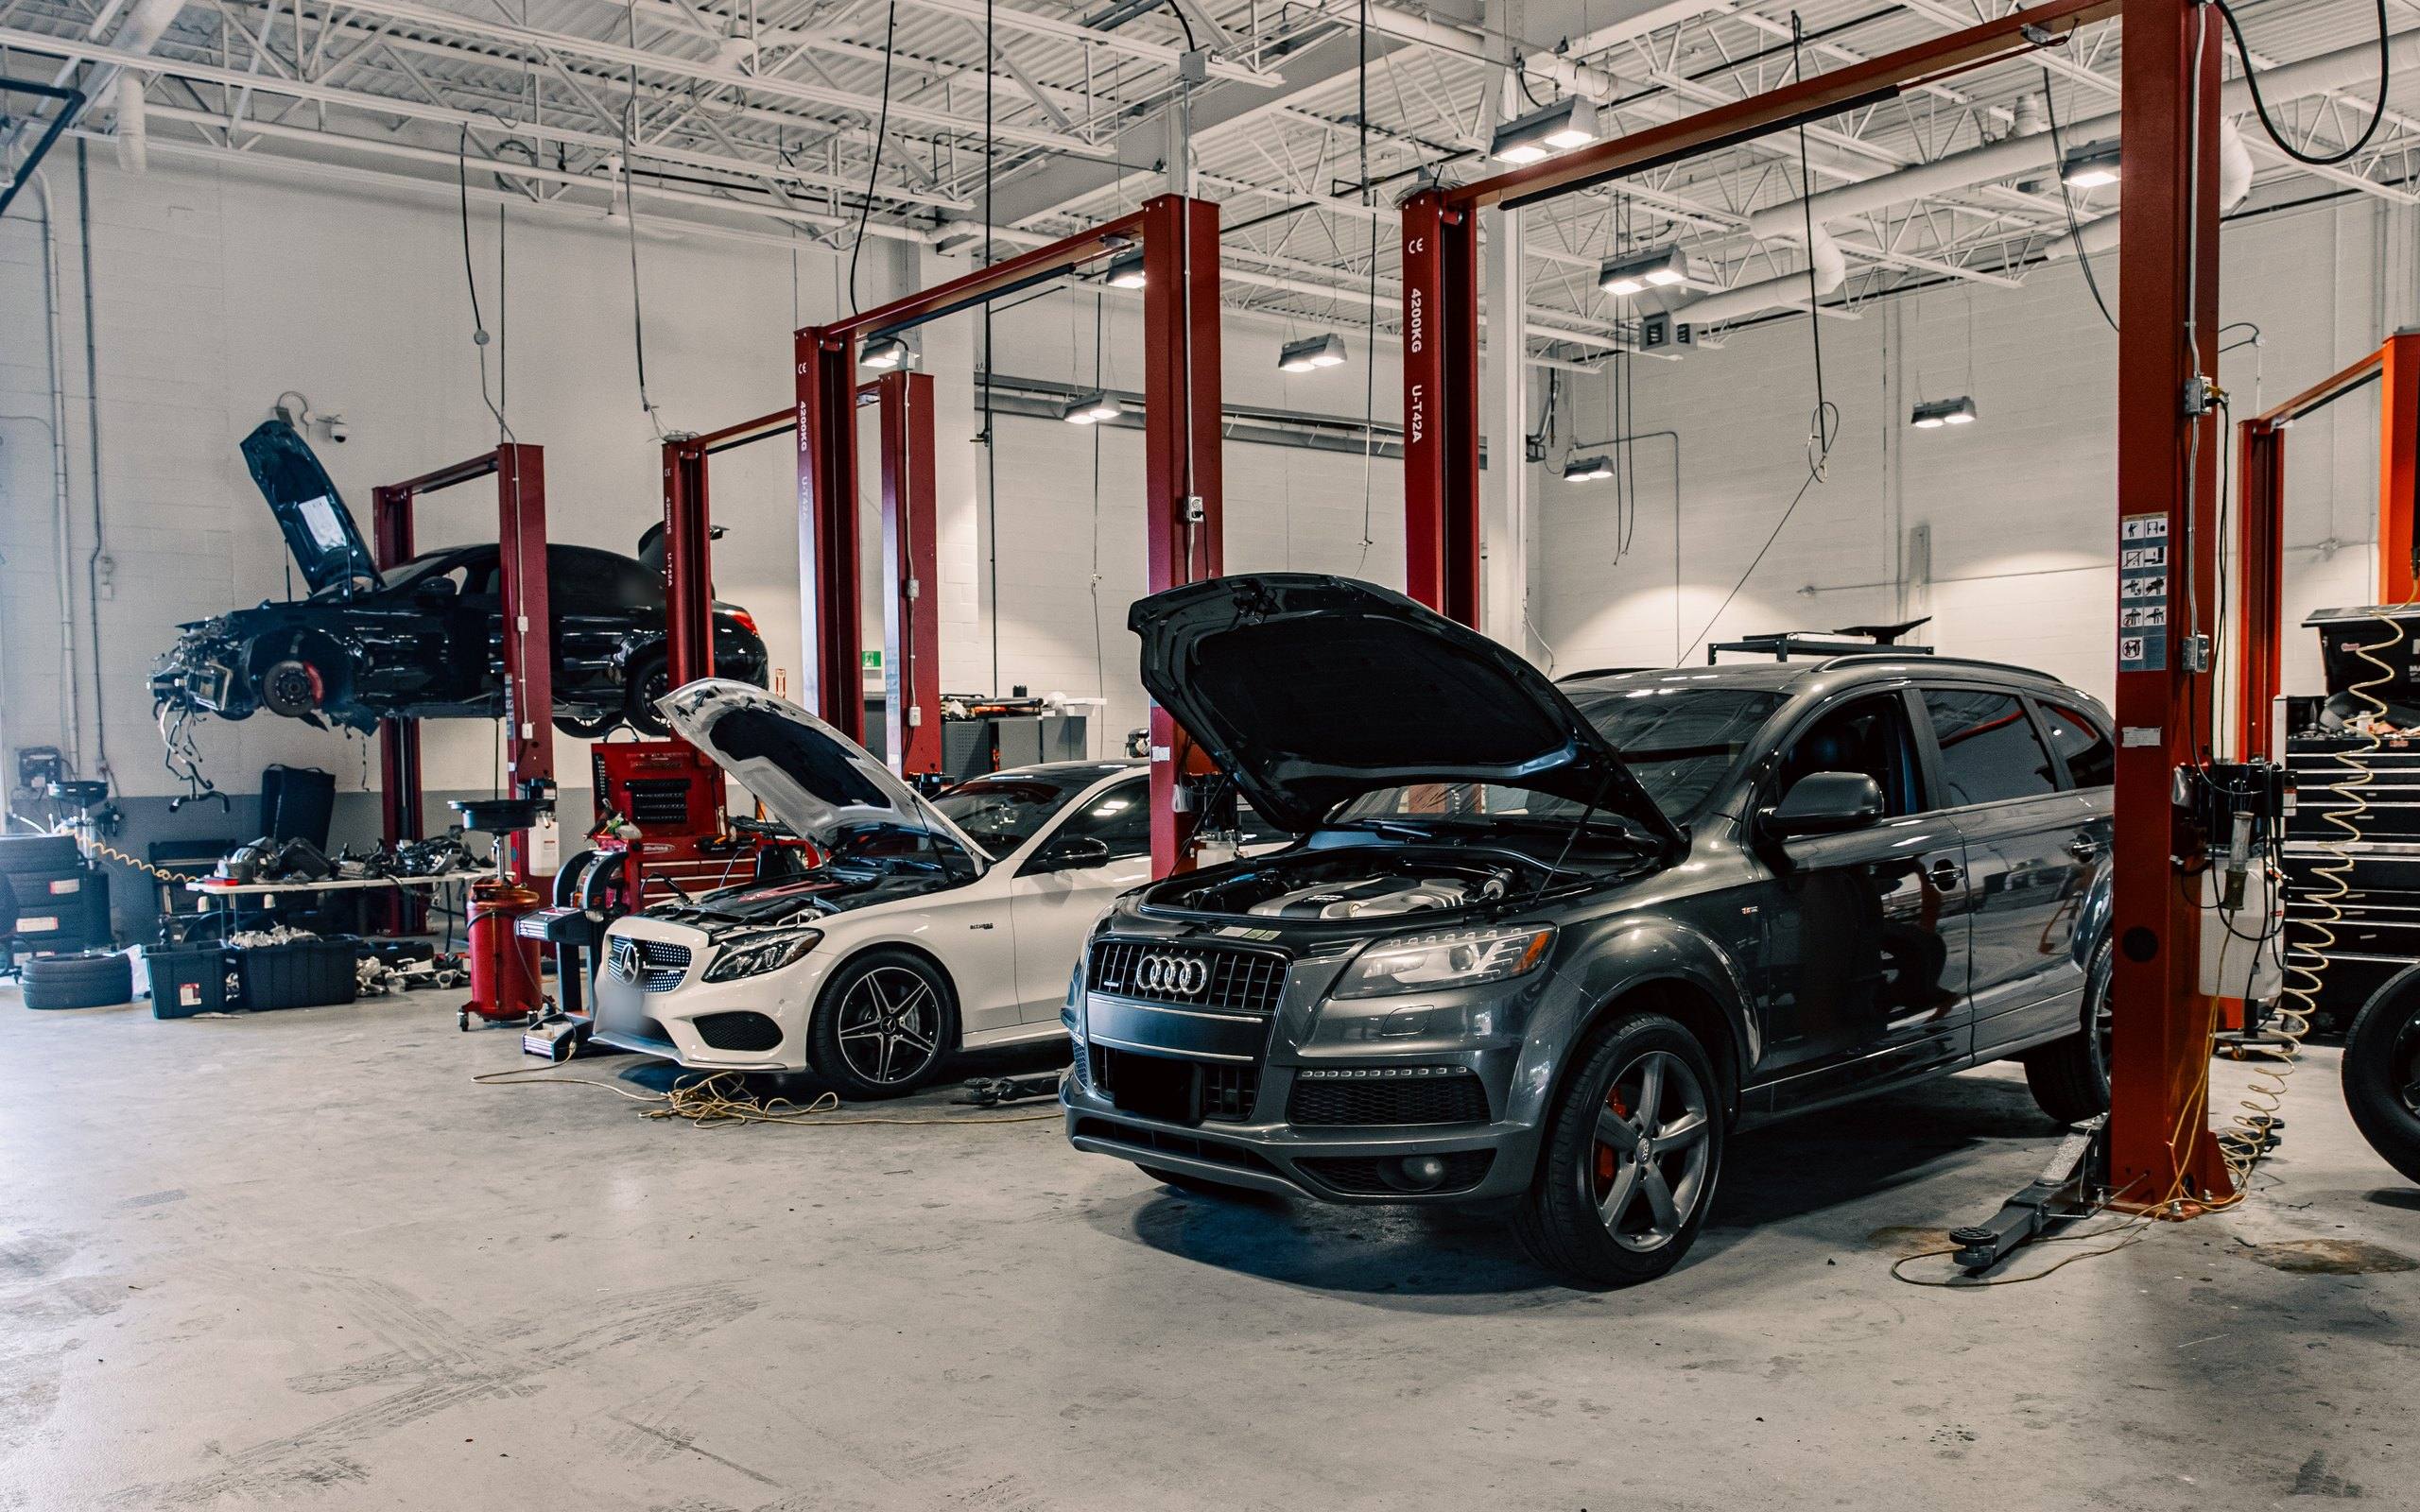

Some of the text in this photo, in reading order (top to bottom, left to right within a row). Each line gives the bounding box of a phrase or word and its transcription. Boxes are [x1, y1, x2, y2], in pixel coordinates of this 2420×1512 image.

[1409, 237, 1424, 254] CE
[798, 362, 807, 374] CE
[1410, 287, 1423, 444] 4200KG U-T42A
